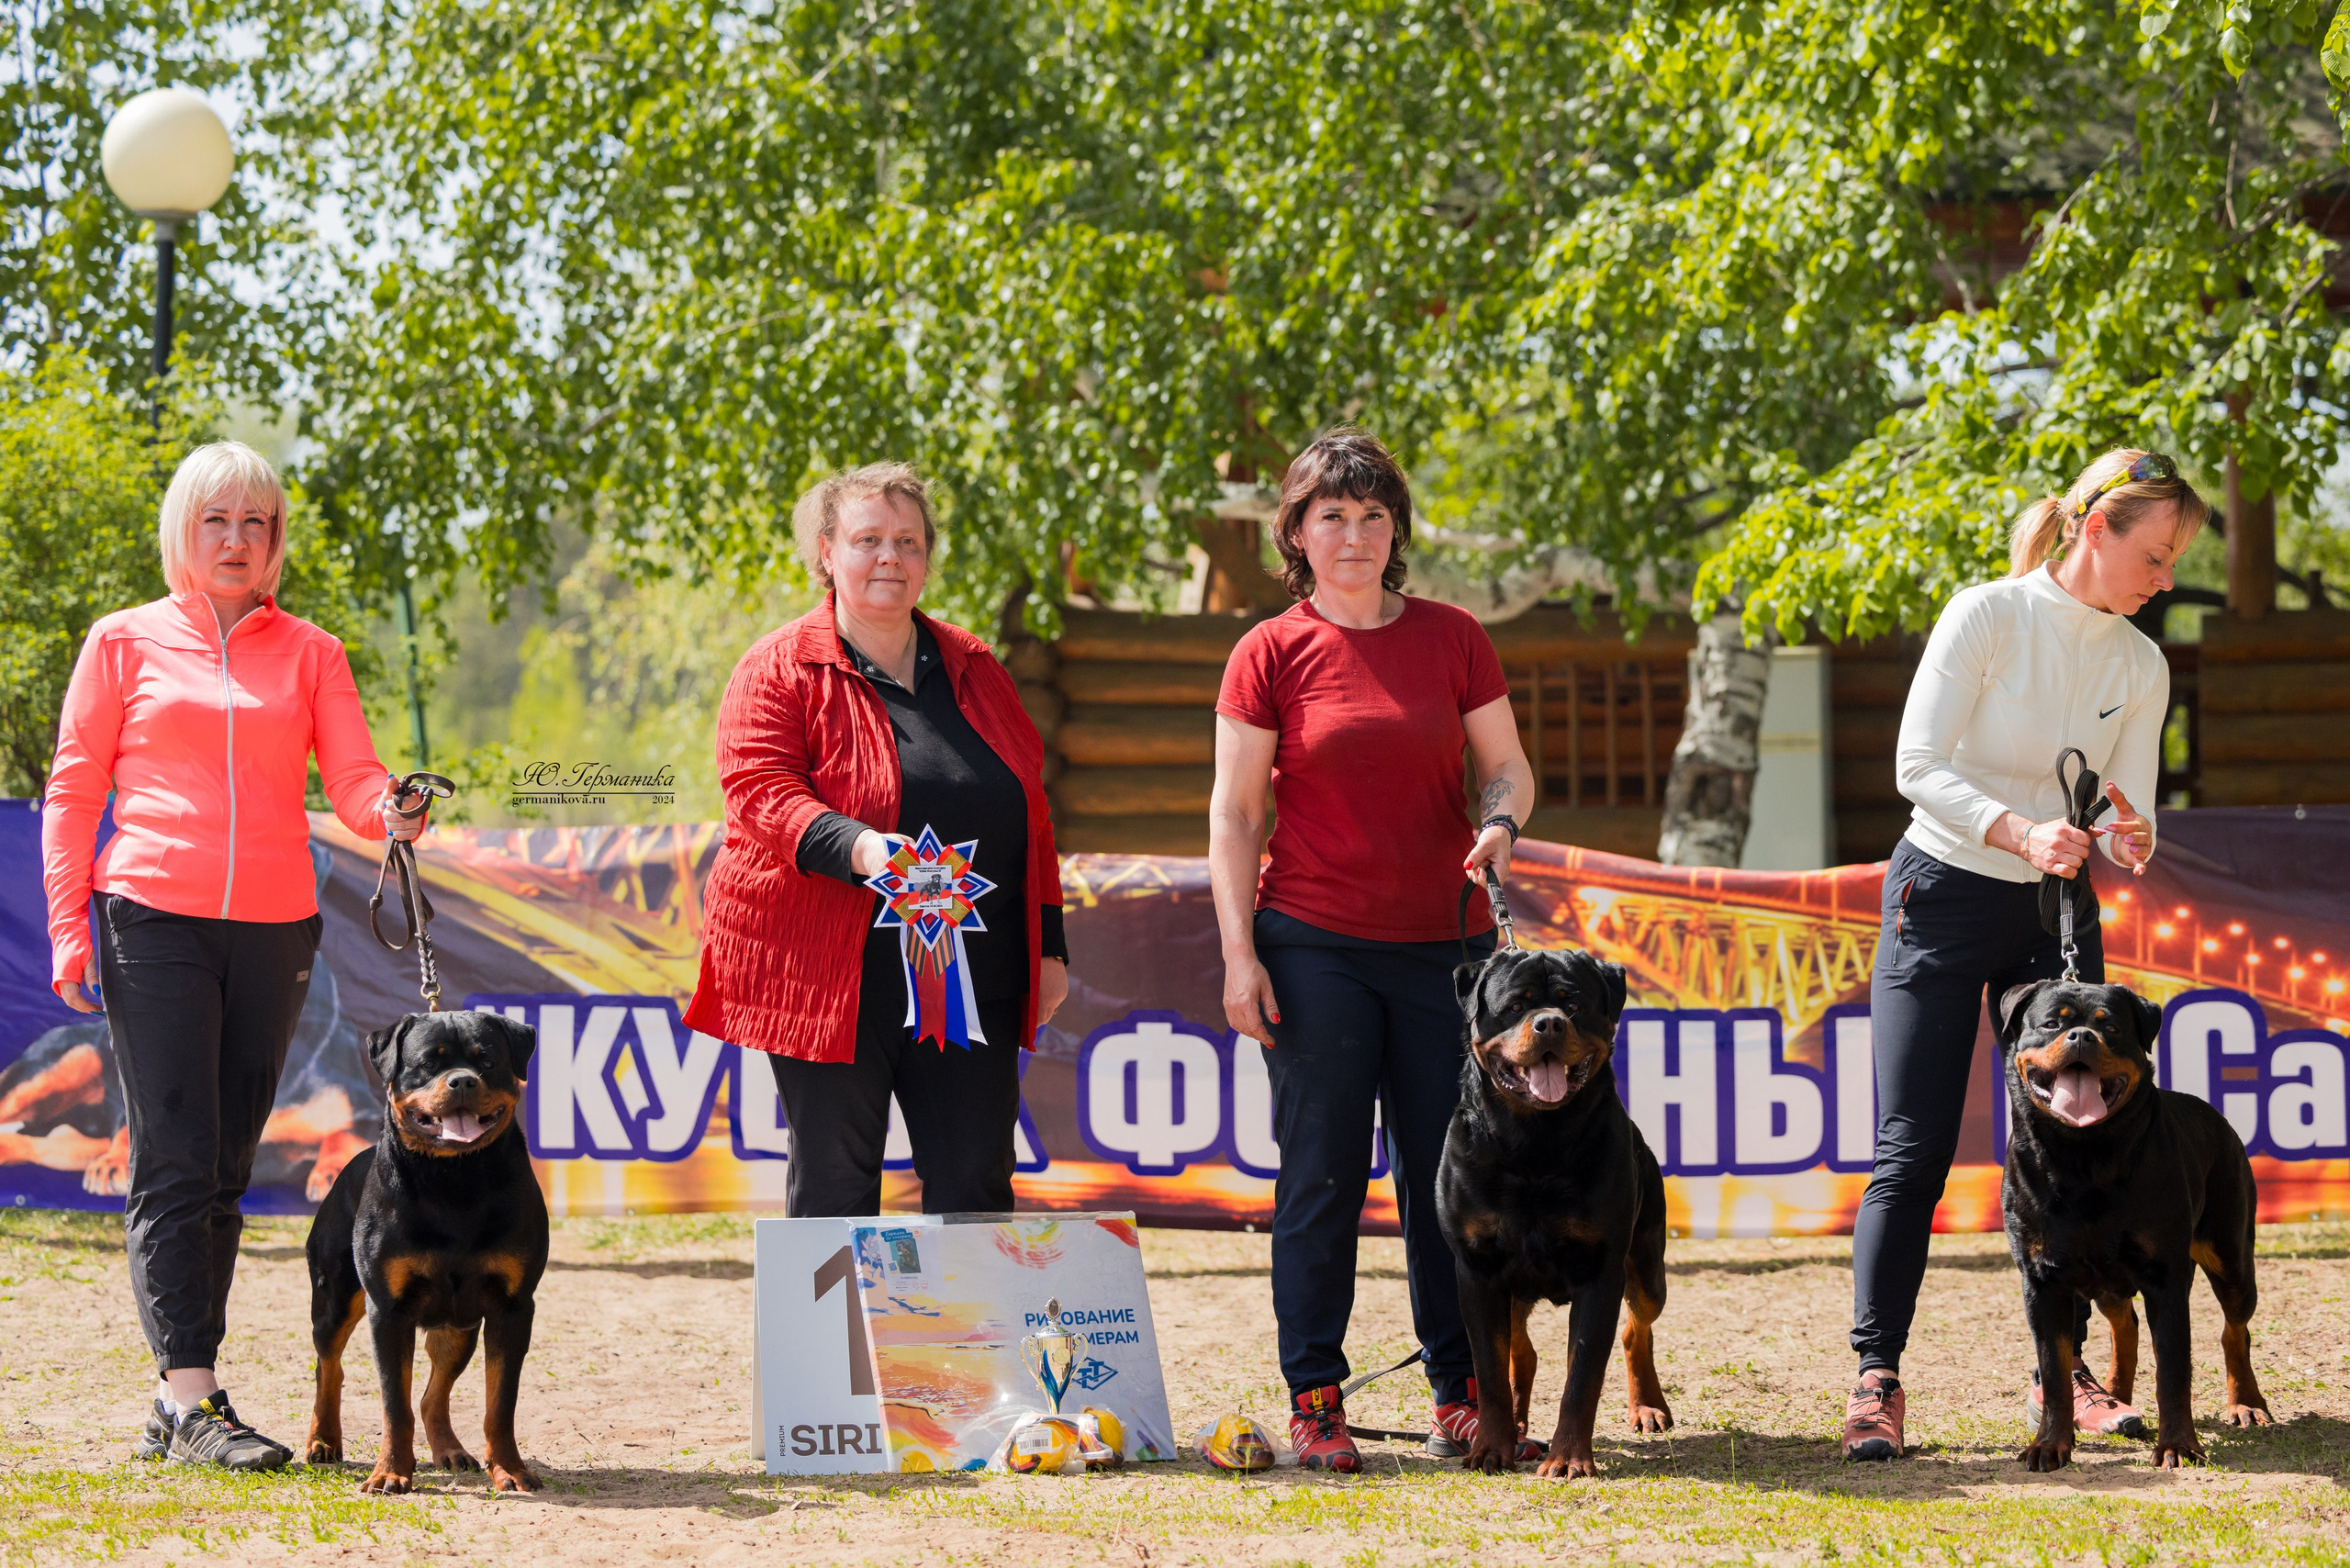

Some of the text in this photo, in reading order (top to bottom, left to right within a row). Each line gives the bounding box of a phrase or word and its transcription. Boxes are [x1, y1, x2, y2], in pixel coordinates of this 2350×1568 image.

[813, 1245, 876, 1395] 1
[1024, 1308, 1136, 1327] РИОВАНИЕ
[790, 1423, 882, 1457] SIRI
